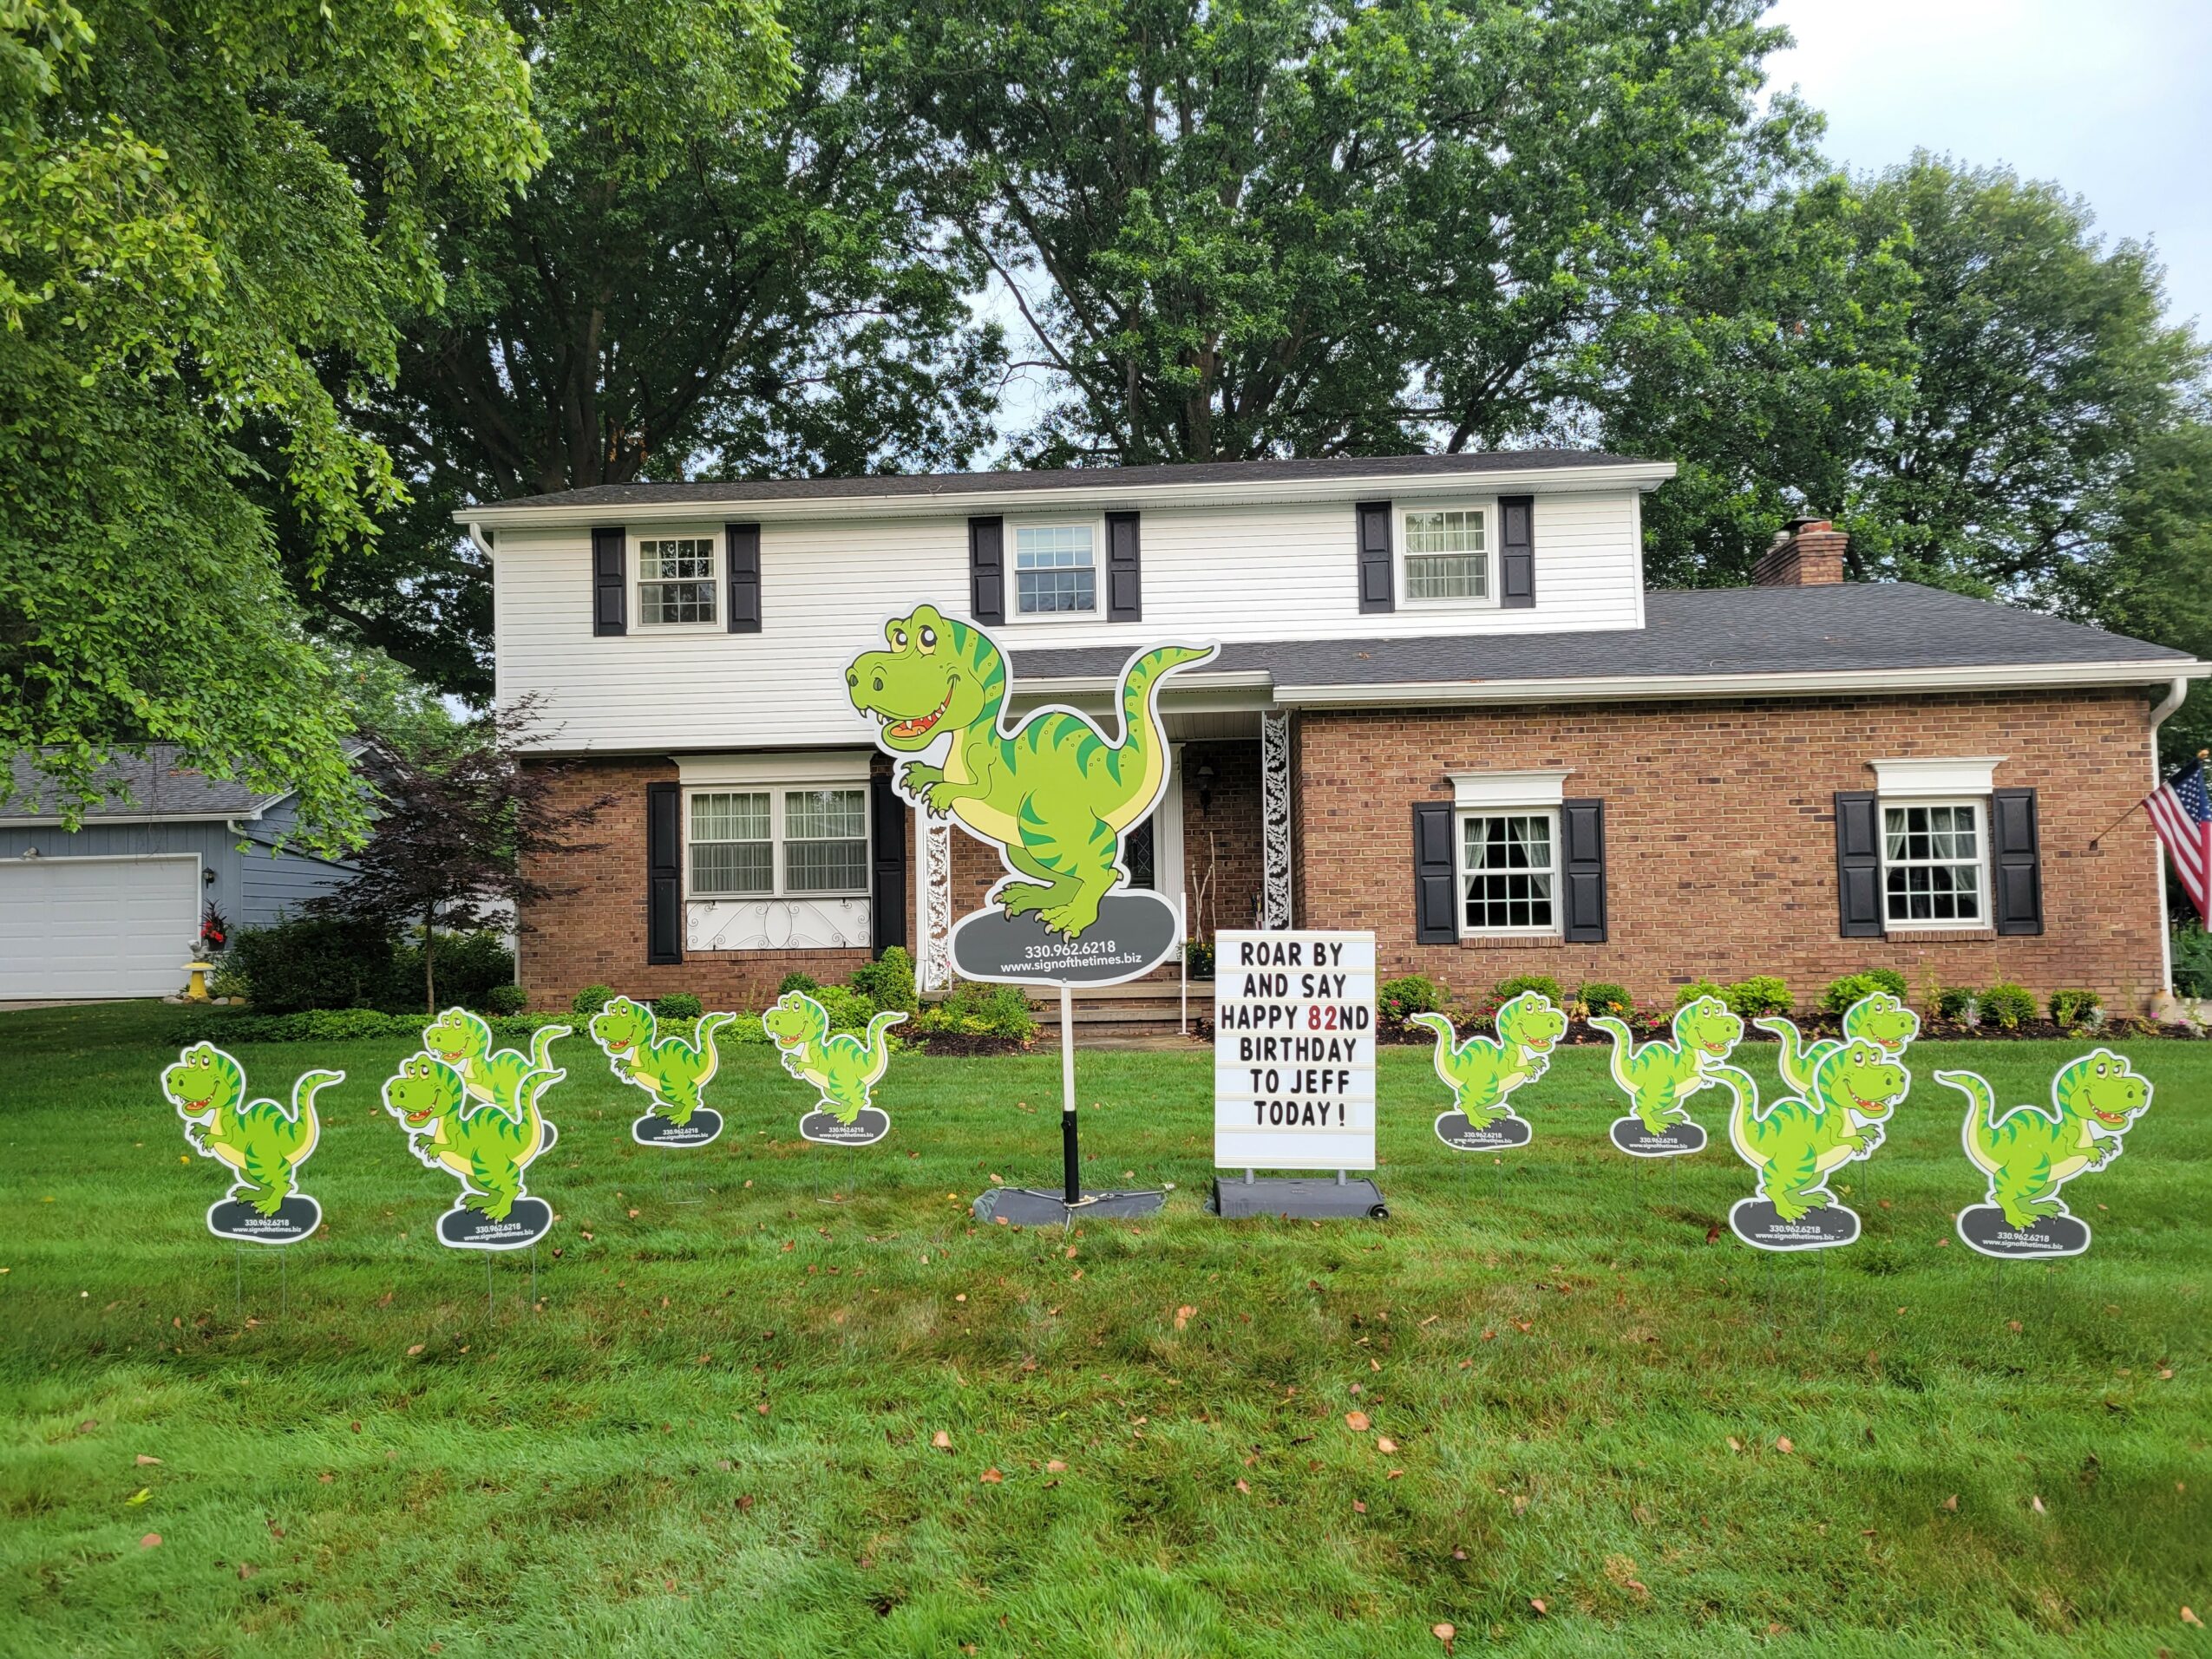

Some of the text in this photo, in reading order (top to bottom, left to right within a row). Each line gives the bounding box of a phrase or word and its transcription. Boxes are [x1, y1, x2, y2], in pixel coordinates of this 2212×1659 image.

[1024, 941, 1116, 959] 330.962.6218
[1241, 942, 1343, 966] ROAR BY
[1000, 953, 1142, 972] www.signofthetimes.biz
[1243, 973, 1346, 998] AND SAY
[1221, 1005, 1369, 1030] HAPPY 82ND
[1240, 1037, 1356, 1062] BIRTHDAY
[1250, 1068, 1350, 1094] TO JEFF
[464, 1229, 534, 1241] www.signofthetimes.biz
[475, 1223, 521, 1234] 330.962.6218
[1755, 1232, 1835, 1242] www.signofthetimes.biz
[1769, 1225, 1821, 1234] 330.962.6218
[1997, 1231, 2050, 1243] 330.962.6218
[1982, 1238, 2064, 1250] www.signofthetimes.biz
